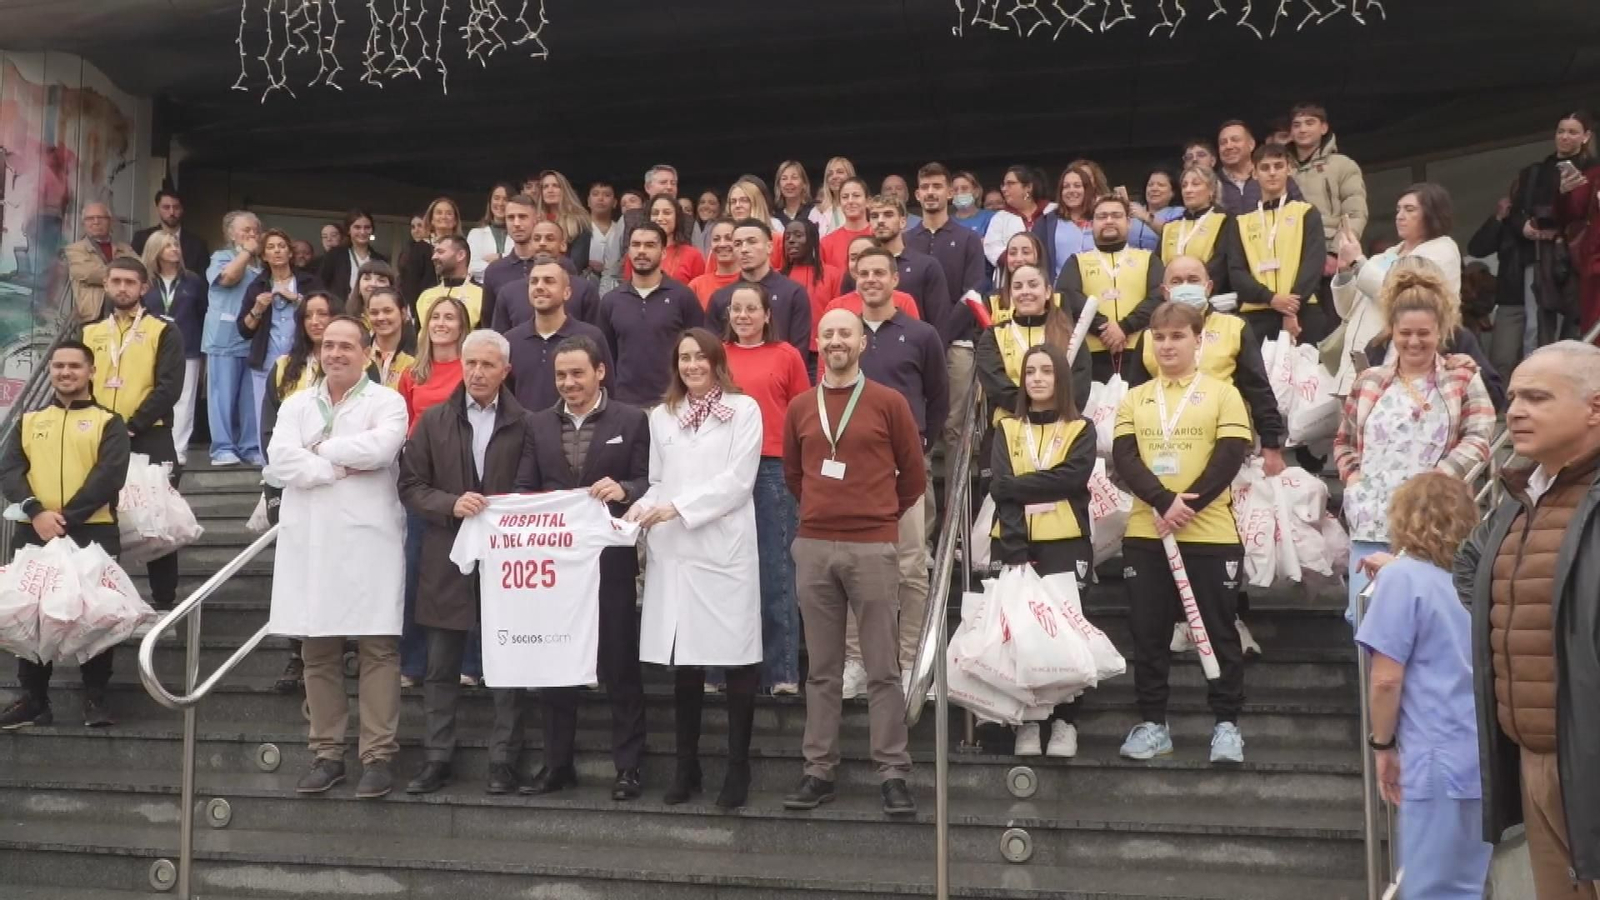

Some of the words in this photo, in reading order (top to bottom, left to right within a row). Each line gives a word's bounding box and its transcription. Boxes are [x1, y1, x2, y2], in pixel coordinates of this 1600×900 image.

[1140, 427, 1204, 436] VOLUARIOS
[498, 513, 567, 528] HOSPITAL
[489, 534, 501, 549] V.
[503, 533, 523, 549] DEL
[527, 532, 574, 548] ROCIO
[501, 559, 557, 589] 2025
